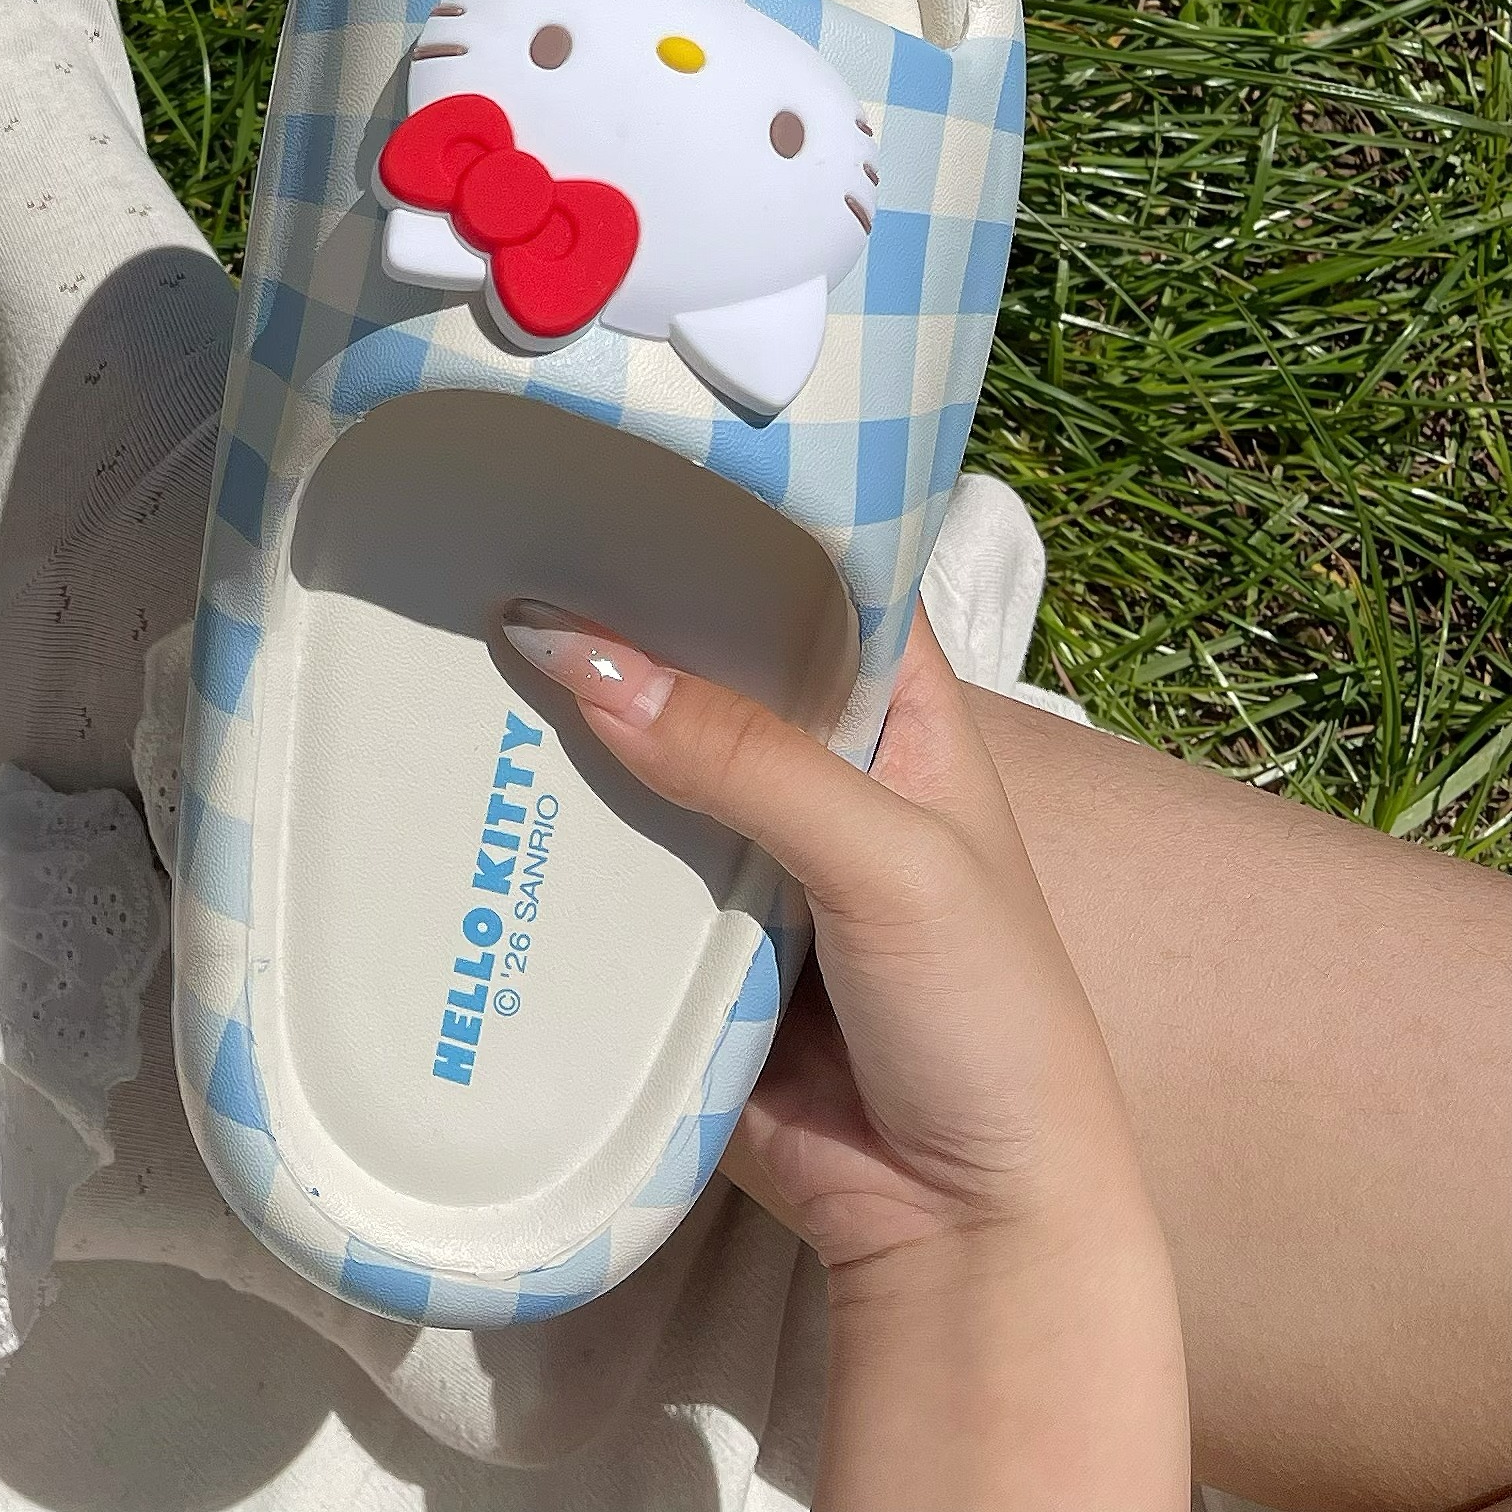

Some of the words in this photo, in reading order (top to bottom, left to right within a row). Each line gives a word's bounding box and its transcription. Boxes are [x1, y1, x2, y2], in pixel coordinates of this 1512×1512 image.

[432, 907, 504, 1086] HELLO
[471, 709, 544, 895] KITTY
[514, 794, 559, 923] SANRIO
